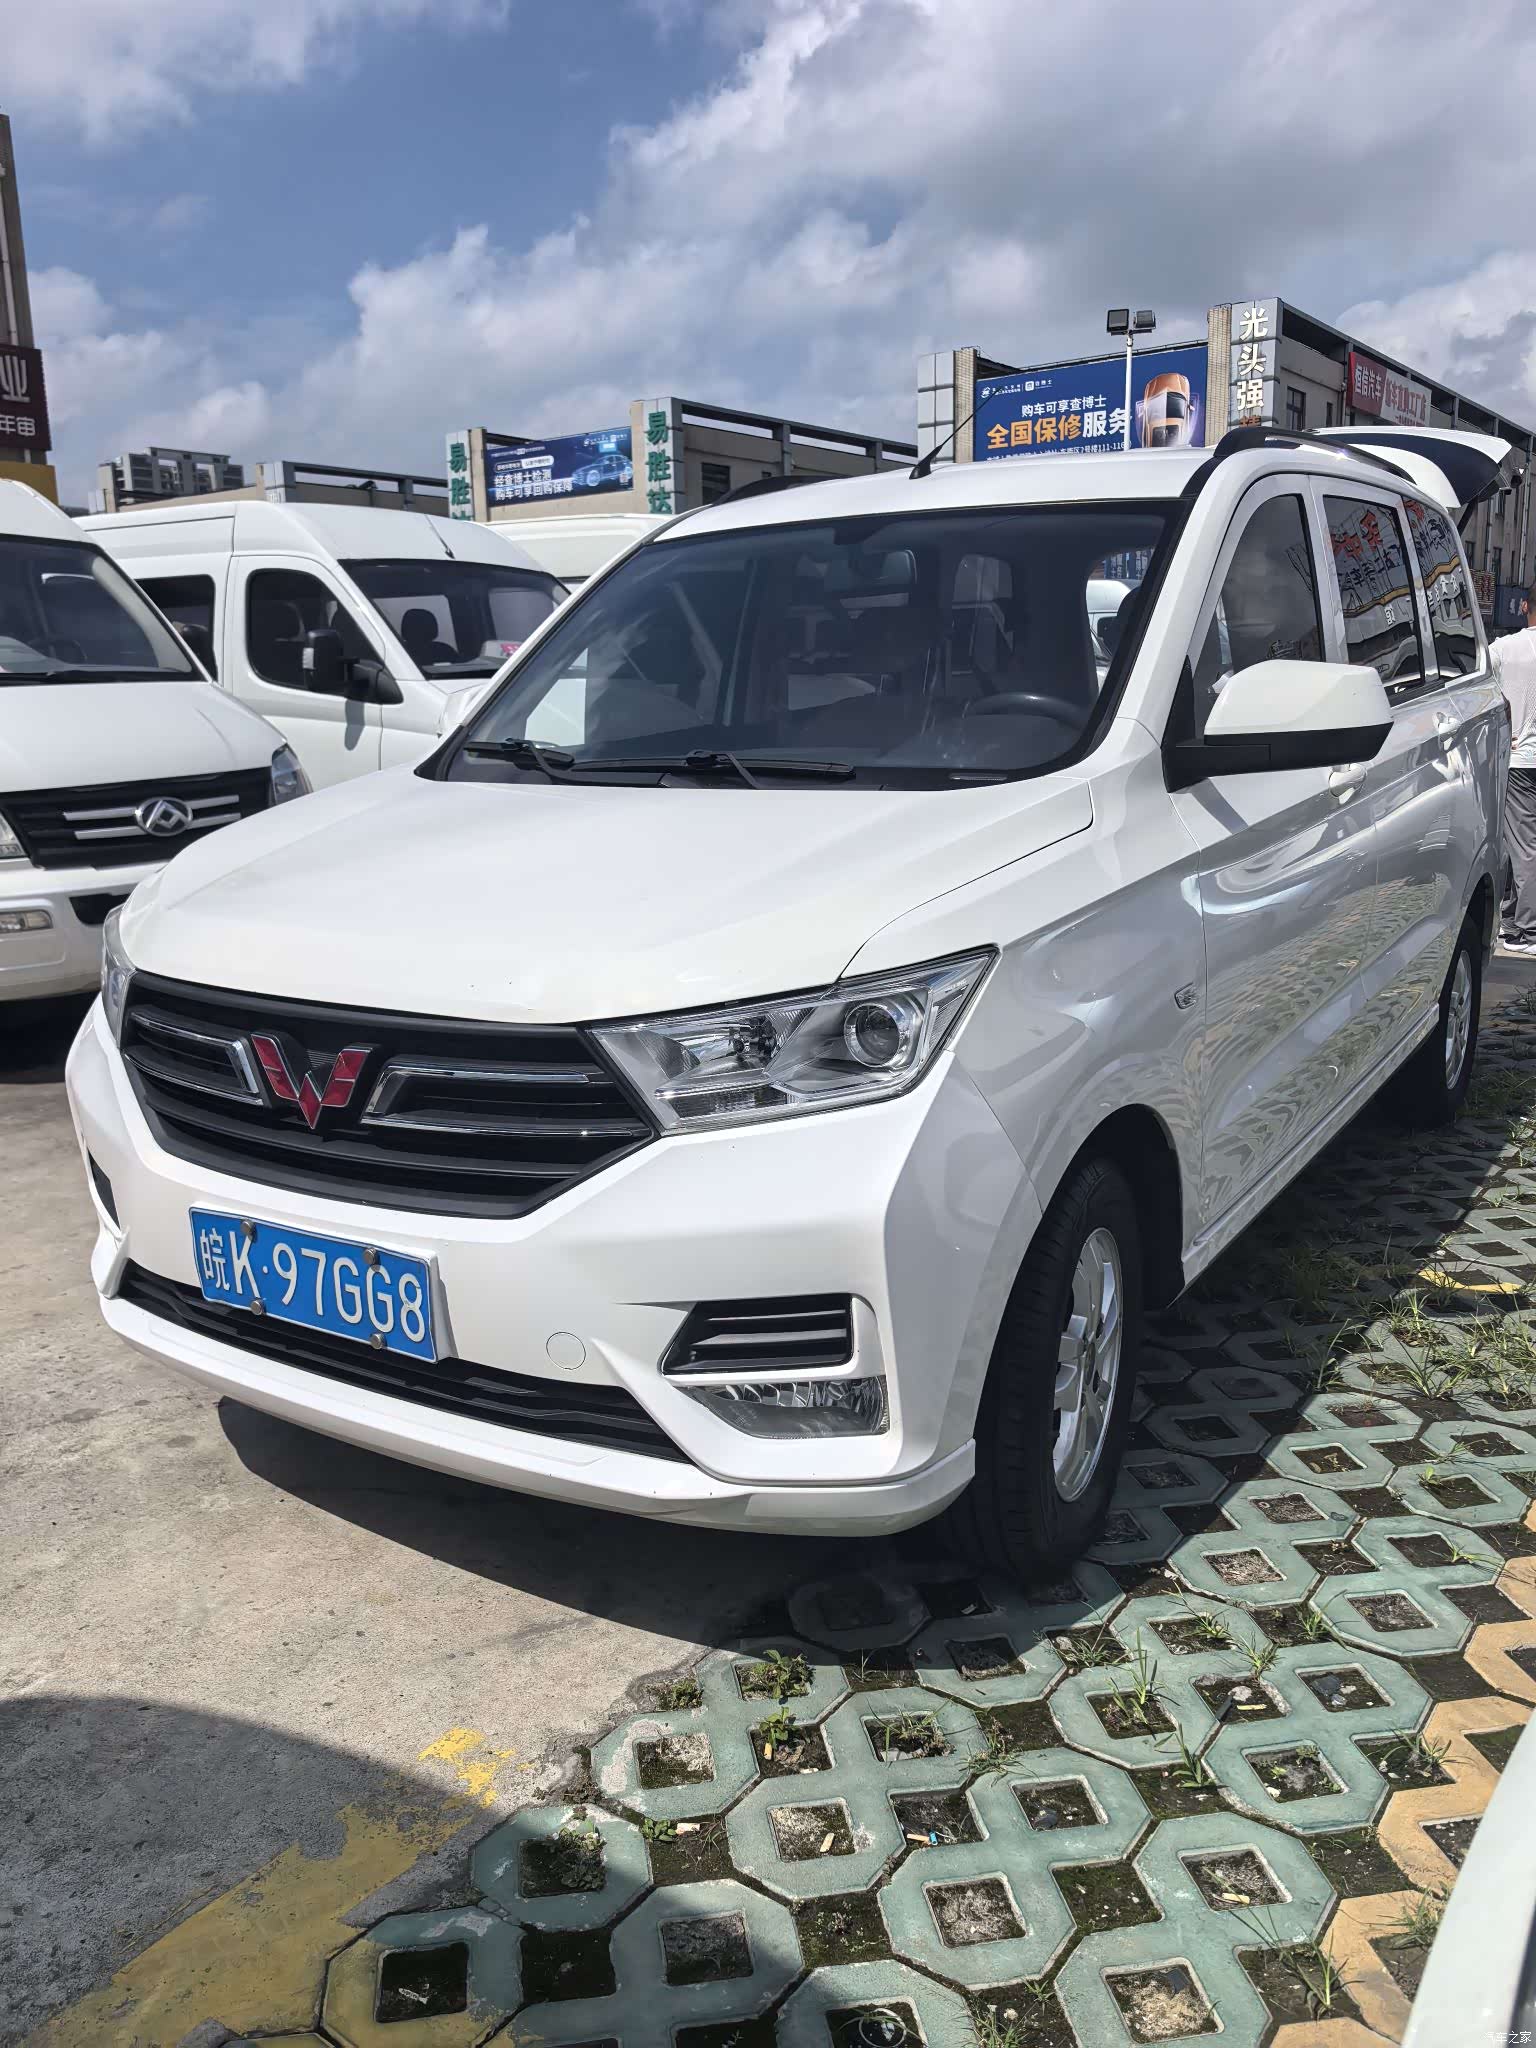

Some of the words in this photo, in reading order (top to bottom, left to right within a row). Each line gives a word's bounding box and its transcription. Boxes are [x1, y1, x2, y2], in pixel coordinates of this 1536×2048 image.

[1237, 307, 1269, 411] 光头强
[986, 407, 1133, 449] 全国保修服务
[1021, 394, 1107, 418] 购车可享查博士
[648, 411, 672, 514] 易胜达
